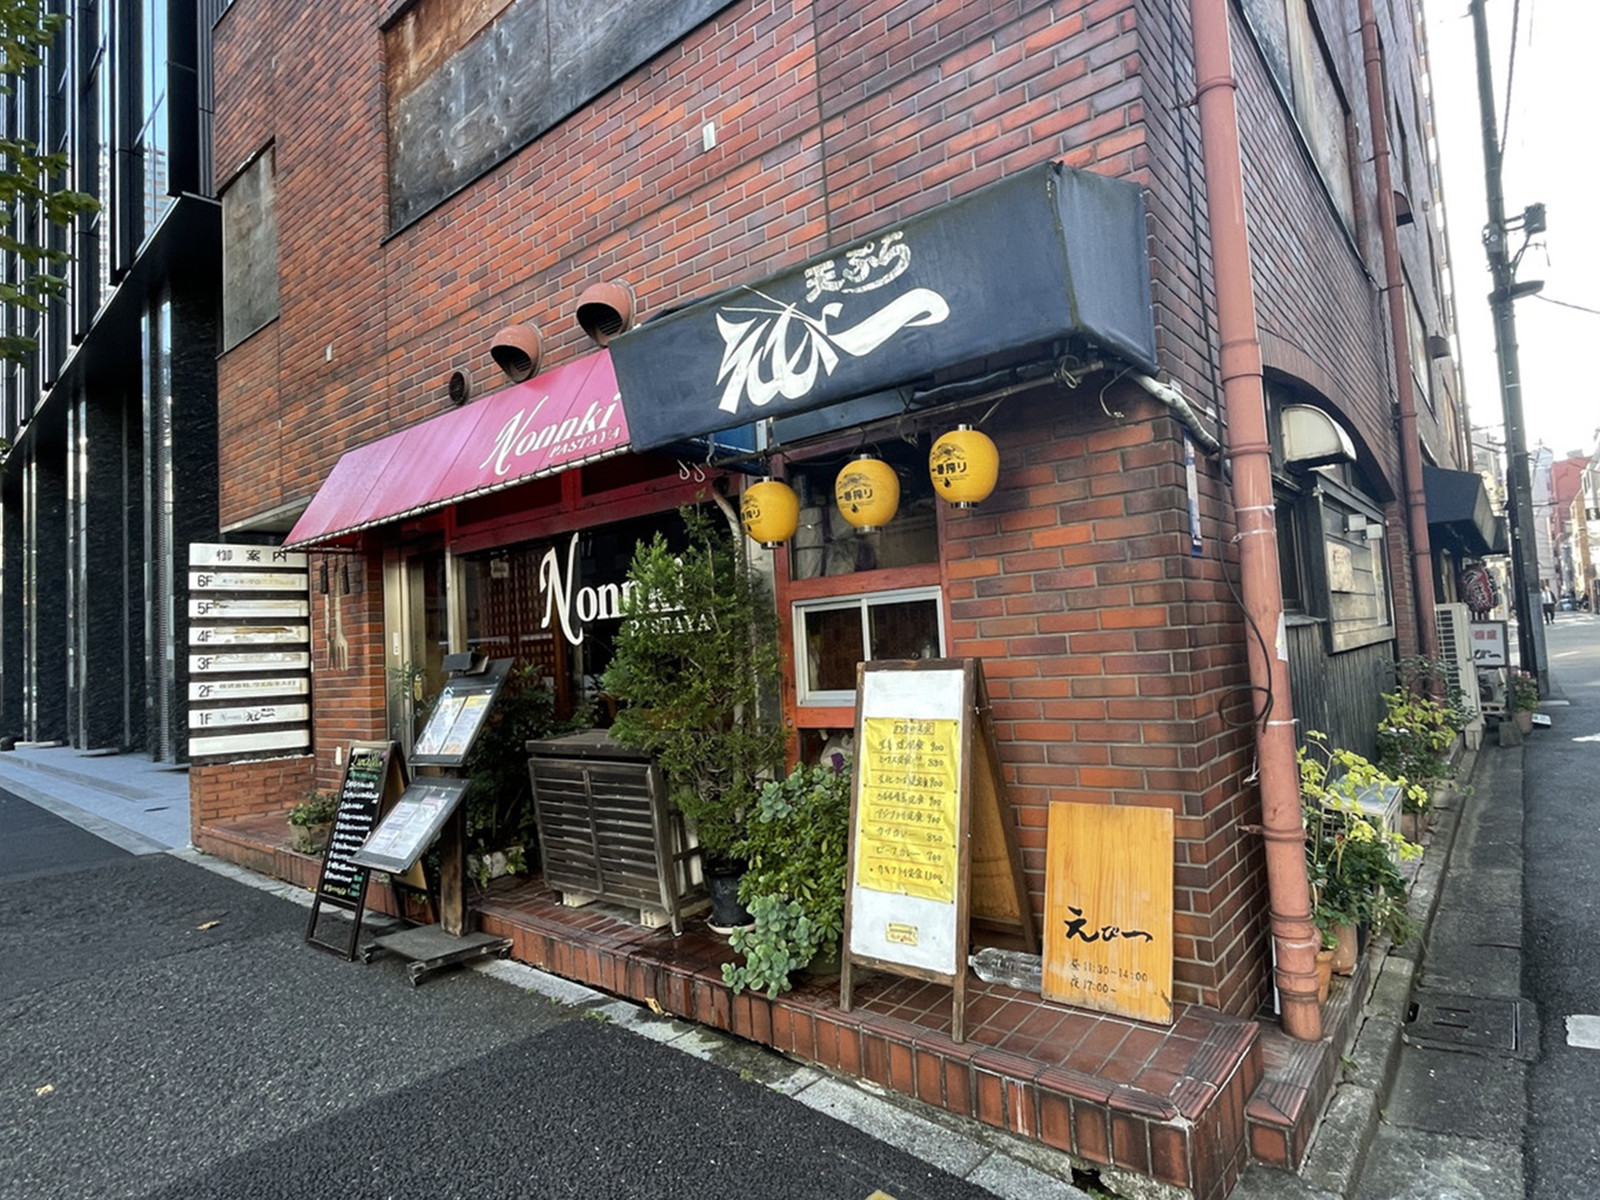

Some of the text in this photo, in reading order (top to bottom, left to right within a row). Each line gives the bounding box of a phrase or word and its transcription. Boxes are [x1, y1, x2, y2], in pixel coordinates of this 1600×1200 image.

[804, 231, 911, 302] 天ぷら
[479, 391, 622, 476] Nonnki
[549, 427, 621, 457] PASTAYA
[931, 462, 967, 475] 一番搾り
[197, 574, 214, 587] 6F
[197, 602, 213, 615] 5F
[197, 630, 212, 643] 4F
[197, 657, 213, 670] 3F
[198, 684, 214, 698] 2F
[199, 712, 212, 725] 1F
